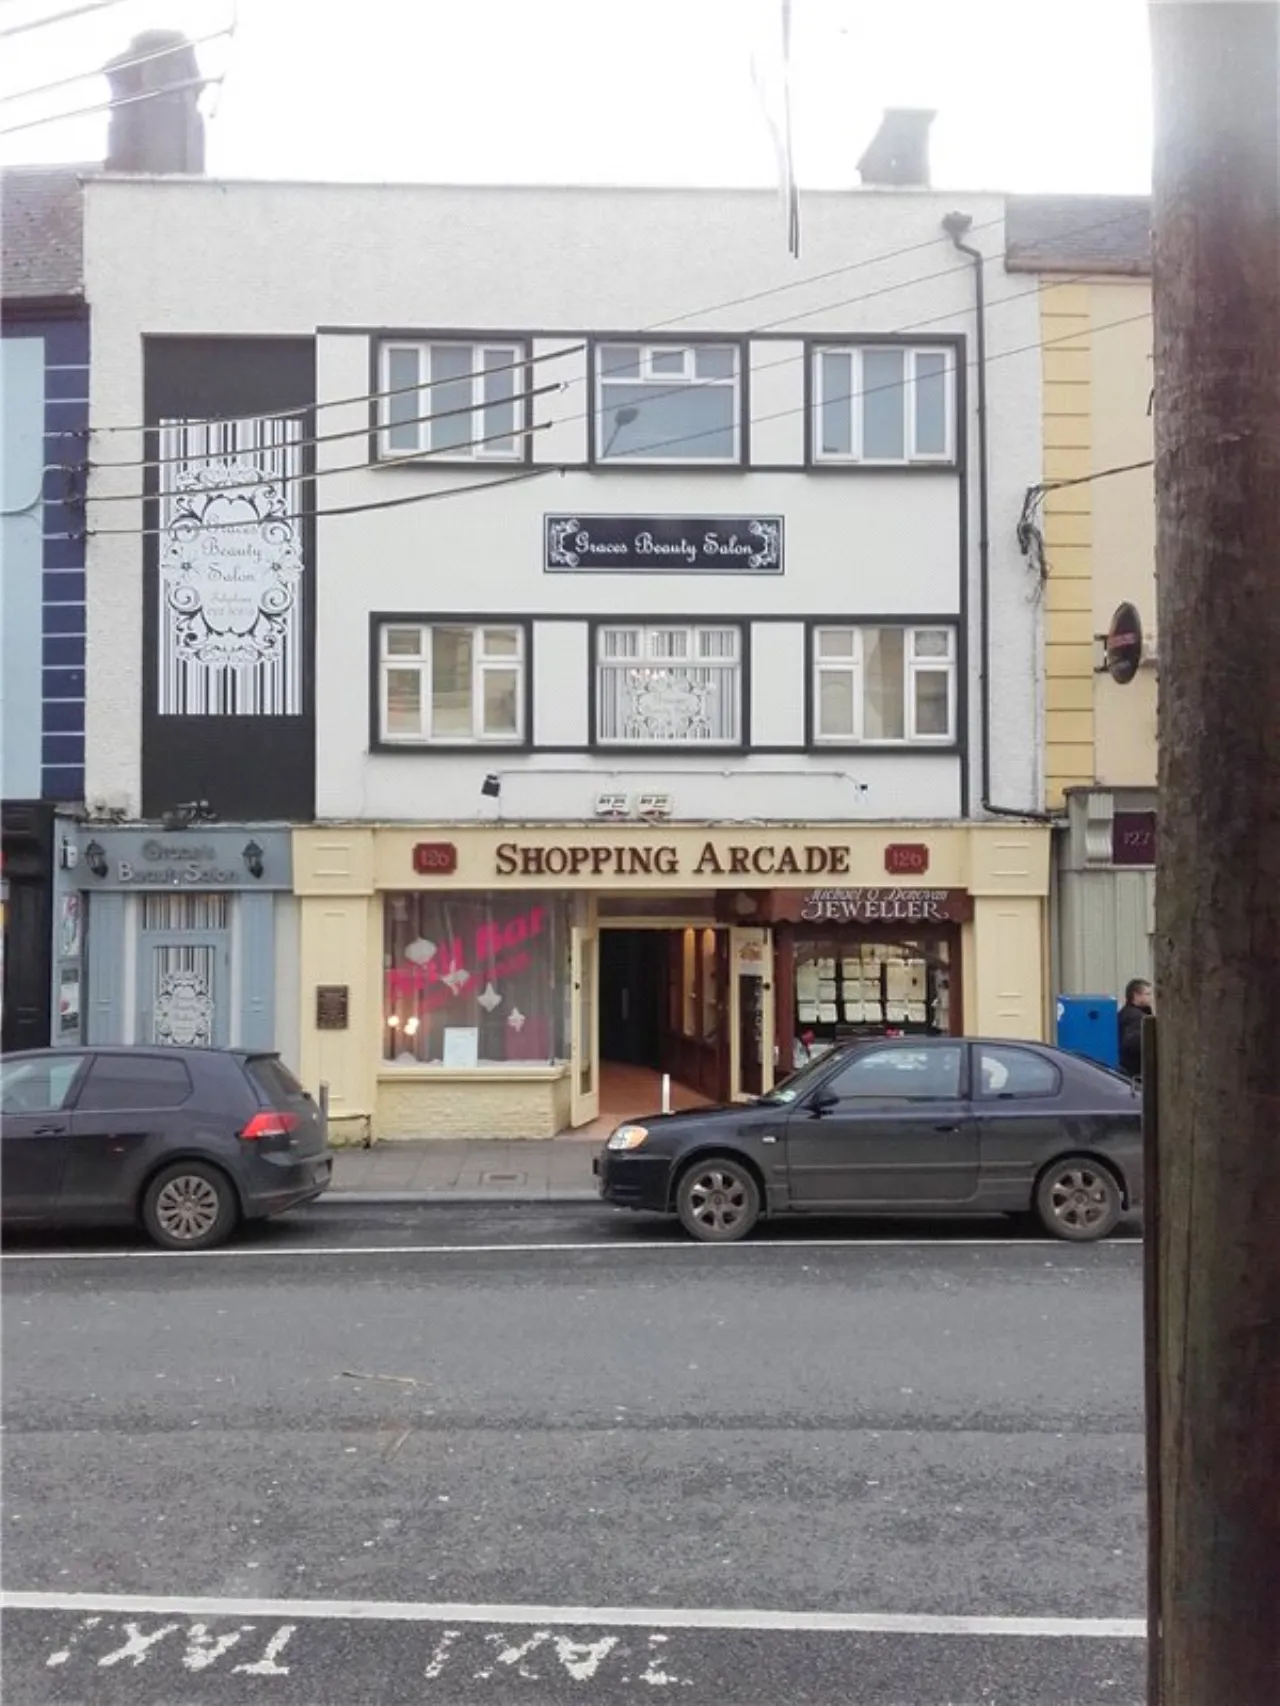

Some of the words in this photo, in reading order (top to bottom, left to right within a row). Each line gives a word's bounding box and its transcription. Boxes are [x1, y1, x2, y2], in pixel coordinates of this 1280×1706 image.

[201, 535, 261, 563] Beauty
[575, 531, 628, 554] Graces
[634, 531, 698, 563] Beauty
[703, 532, 753, 556] Salon
[207, 562, 255, 581] Salon
[495, 842, 679, 876] SHOPPING
[692, 840, 851, 875] ARCADE
[184, 861, 239, 883] Salon
[801, 899, 950, 919] JEWELLER
